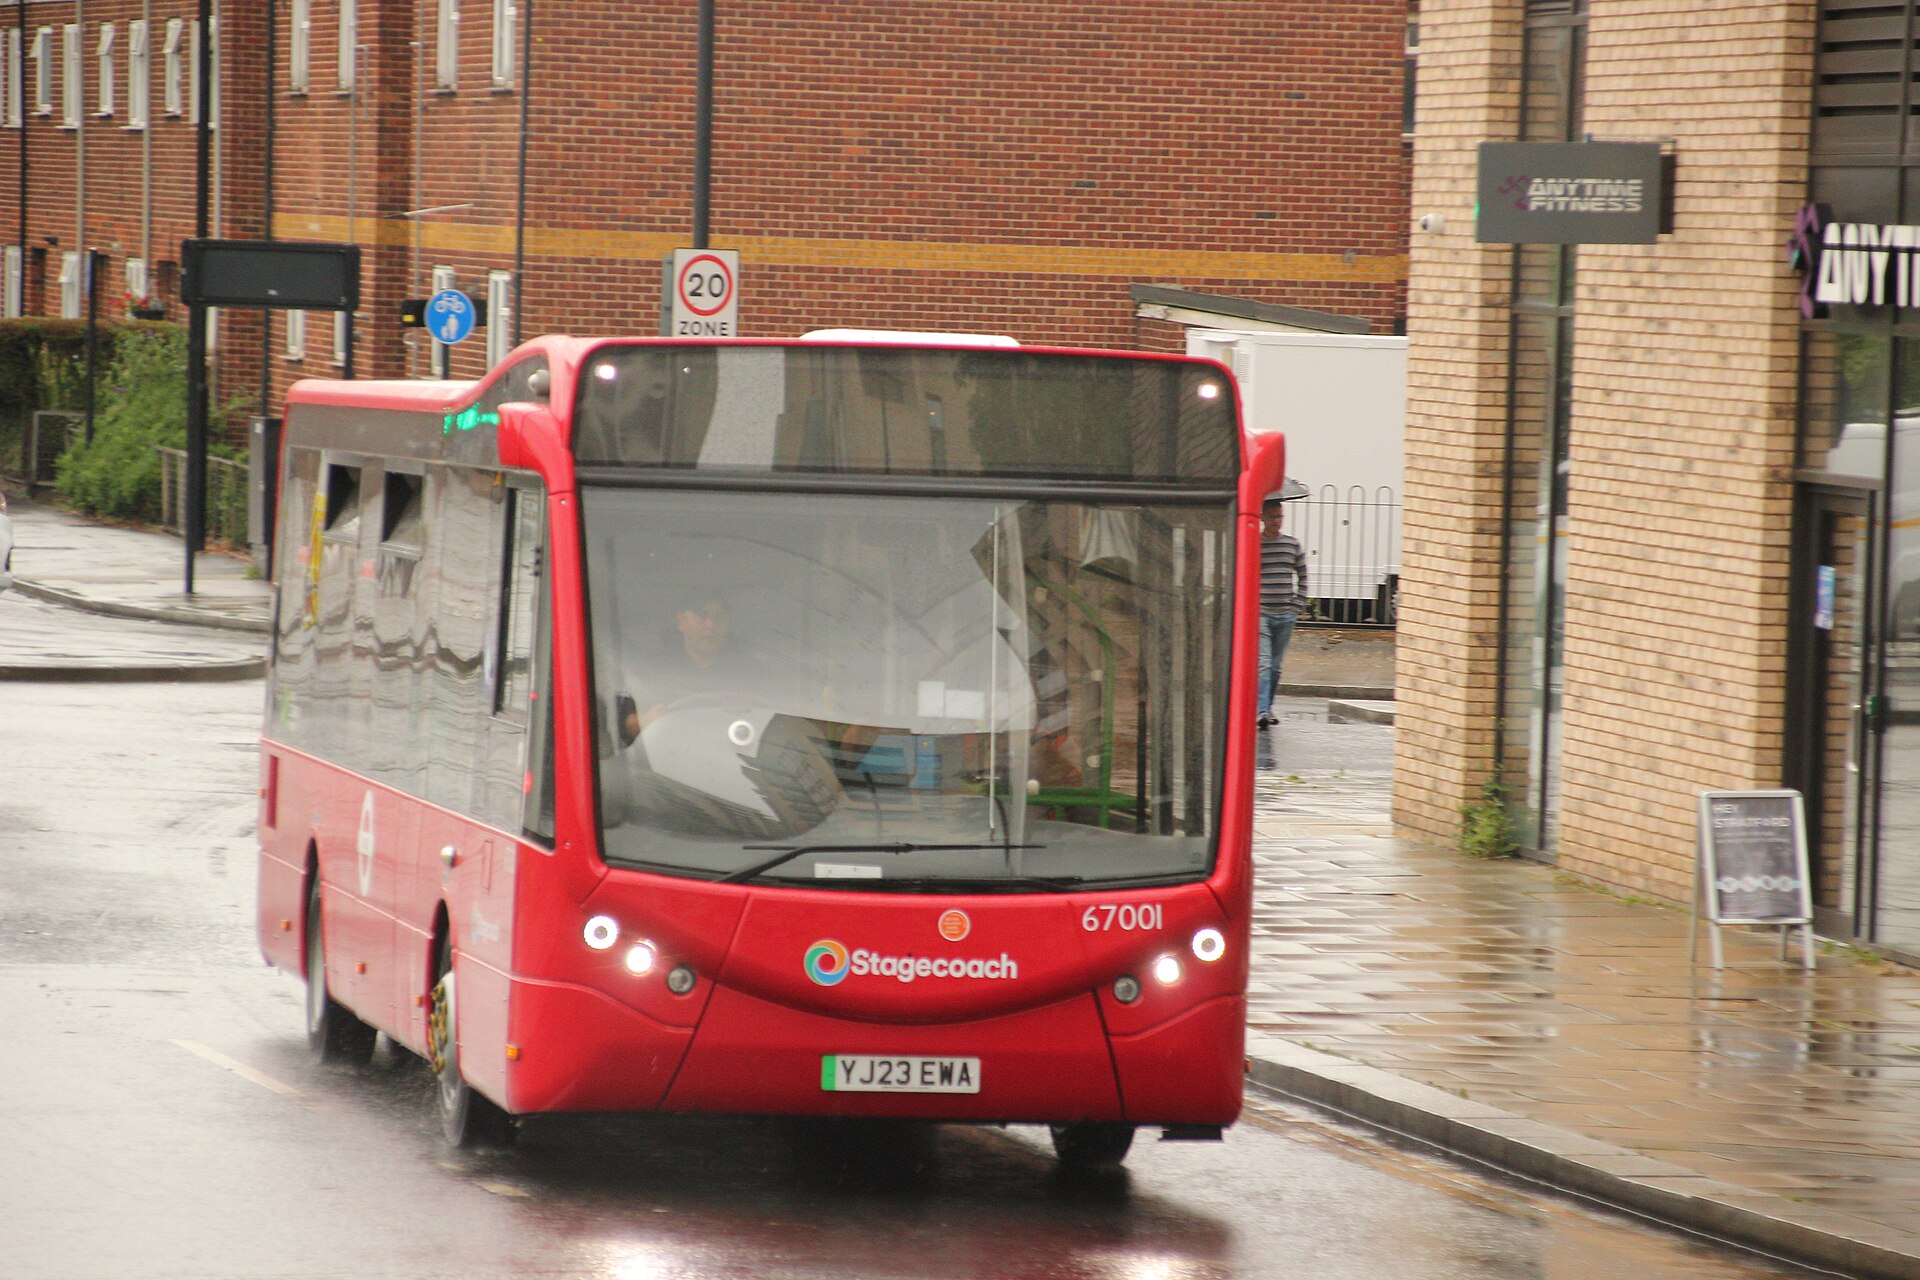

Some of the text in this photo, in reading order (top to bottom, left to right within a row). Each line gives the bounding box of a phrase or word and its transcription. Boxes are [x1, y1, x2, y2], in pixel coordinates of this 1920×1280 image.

[1527, 177, 1644, 197] ANYTIME
[1528, 197, 1643, 212] FITNESS
[688, 273, 725, 297] 20
[679, 321, 728, 336] ZONE
[1081, 903, 1163, 932] 67001
[851, 950, 1018, 983] Stagecoach
[841, 1060, 972, 1087] YJ23 EWA
